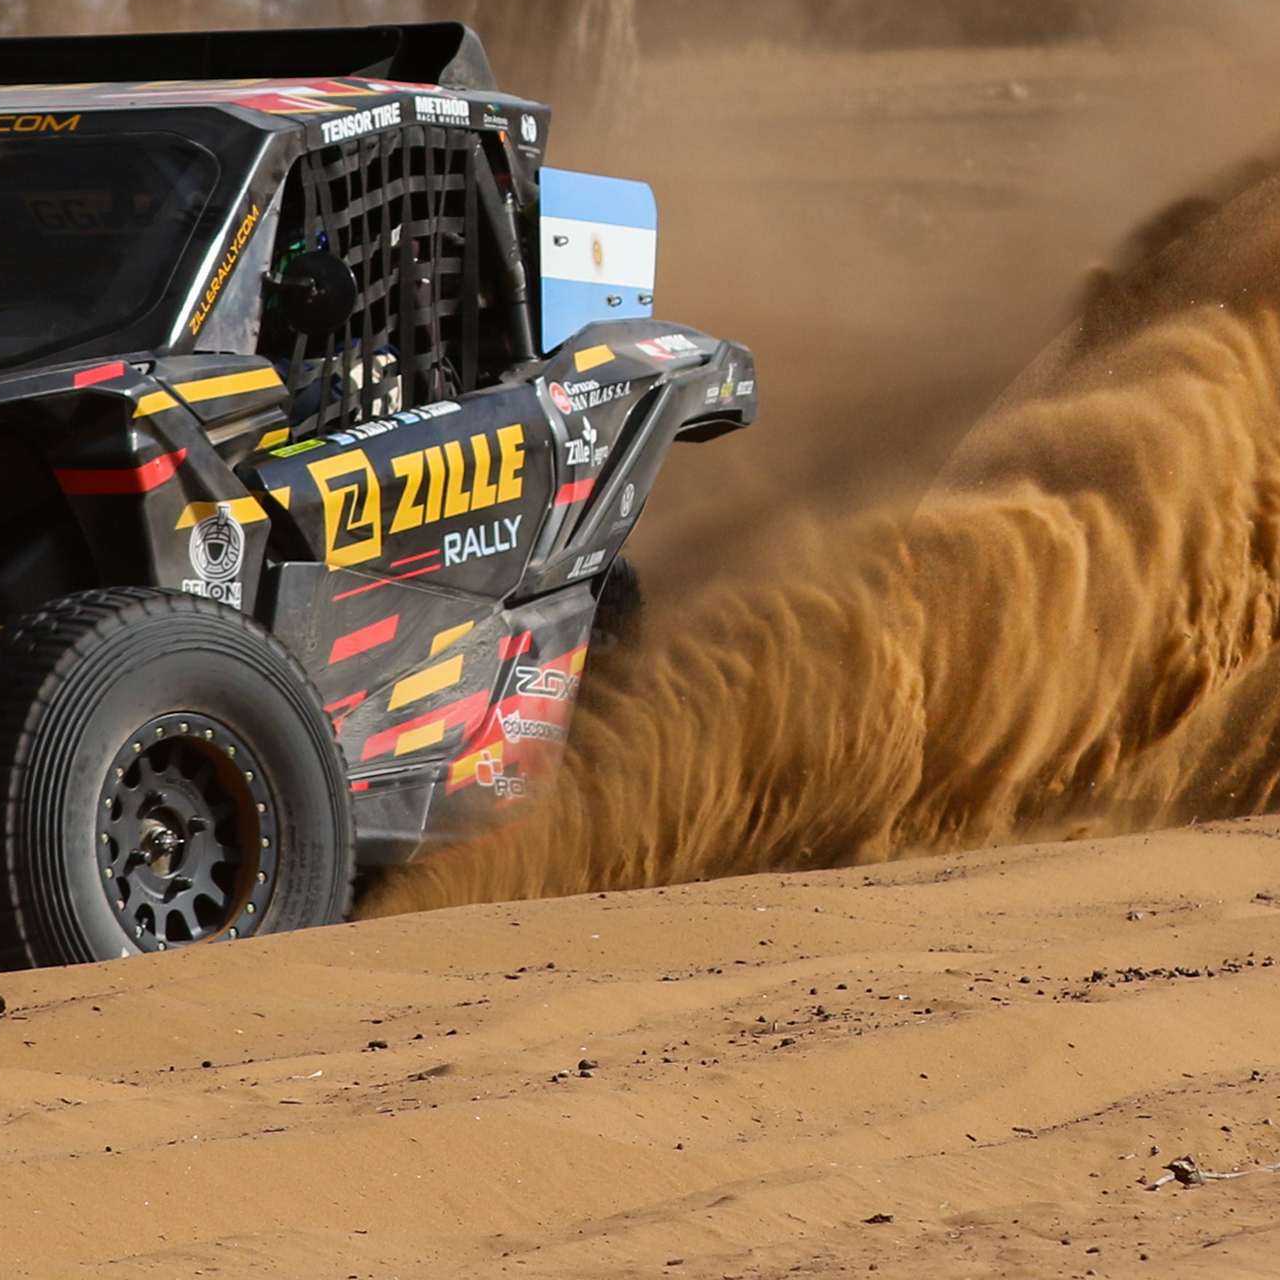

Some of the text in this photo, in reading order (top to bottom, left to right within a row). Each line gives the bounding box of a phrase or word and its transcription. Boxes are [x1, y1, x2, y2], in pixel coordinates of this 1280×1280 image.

[415, 96, 469, 116] METHOD
[321, 102, 401, 143] TENSOR TIRE
[439, 115, 470, 125] WHEELS
[189, 204, 260, 336] ZILLERALLY.COM
[563, 379, 600, 395] Gruas
[569, 393, 588, 412] SAN
[589, 385, 615, 408] BLAS
[564, 438, 590, 465] Zille
[389, 424, 526, 535] ZILLE
[444, 514, 523, 567] RALLY
